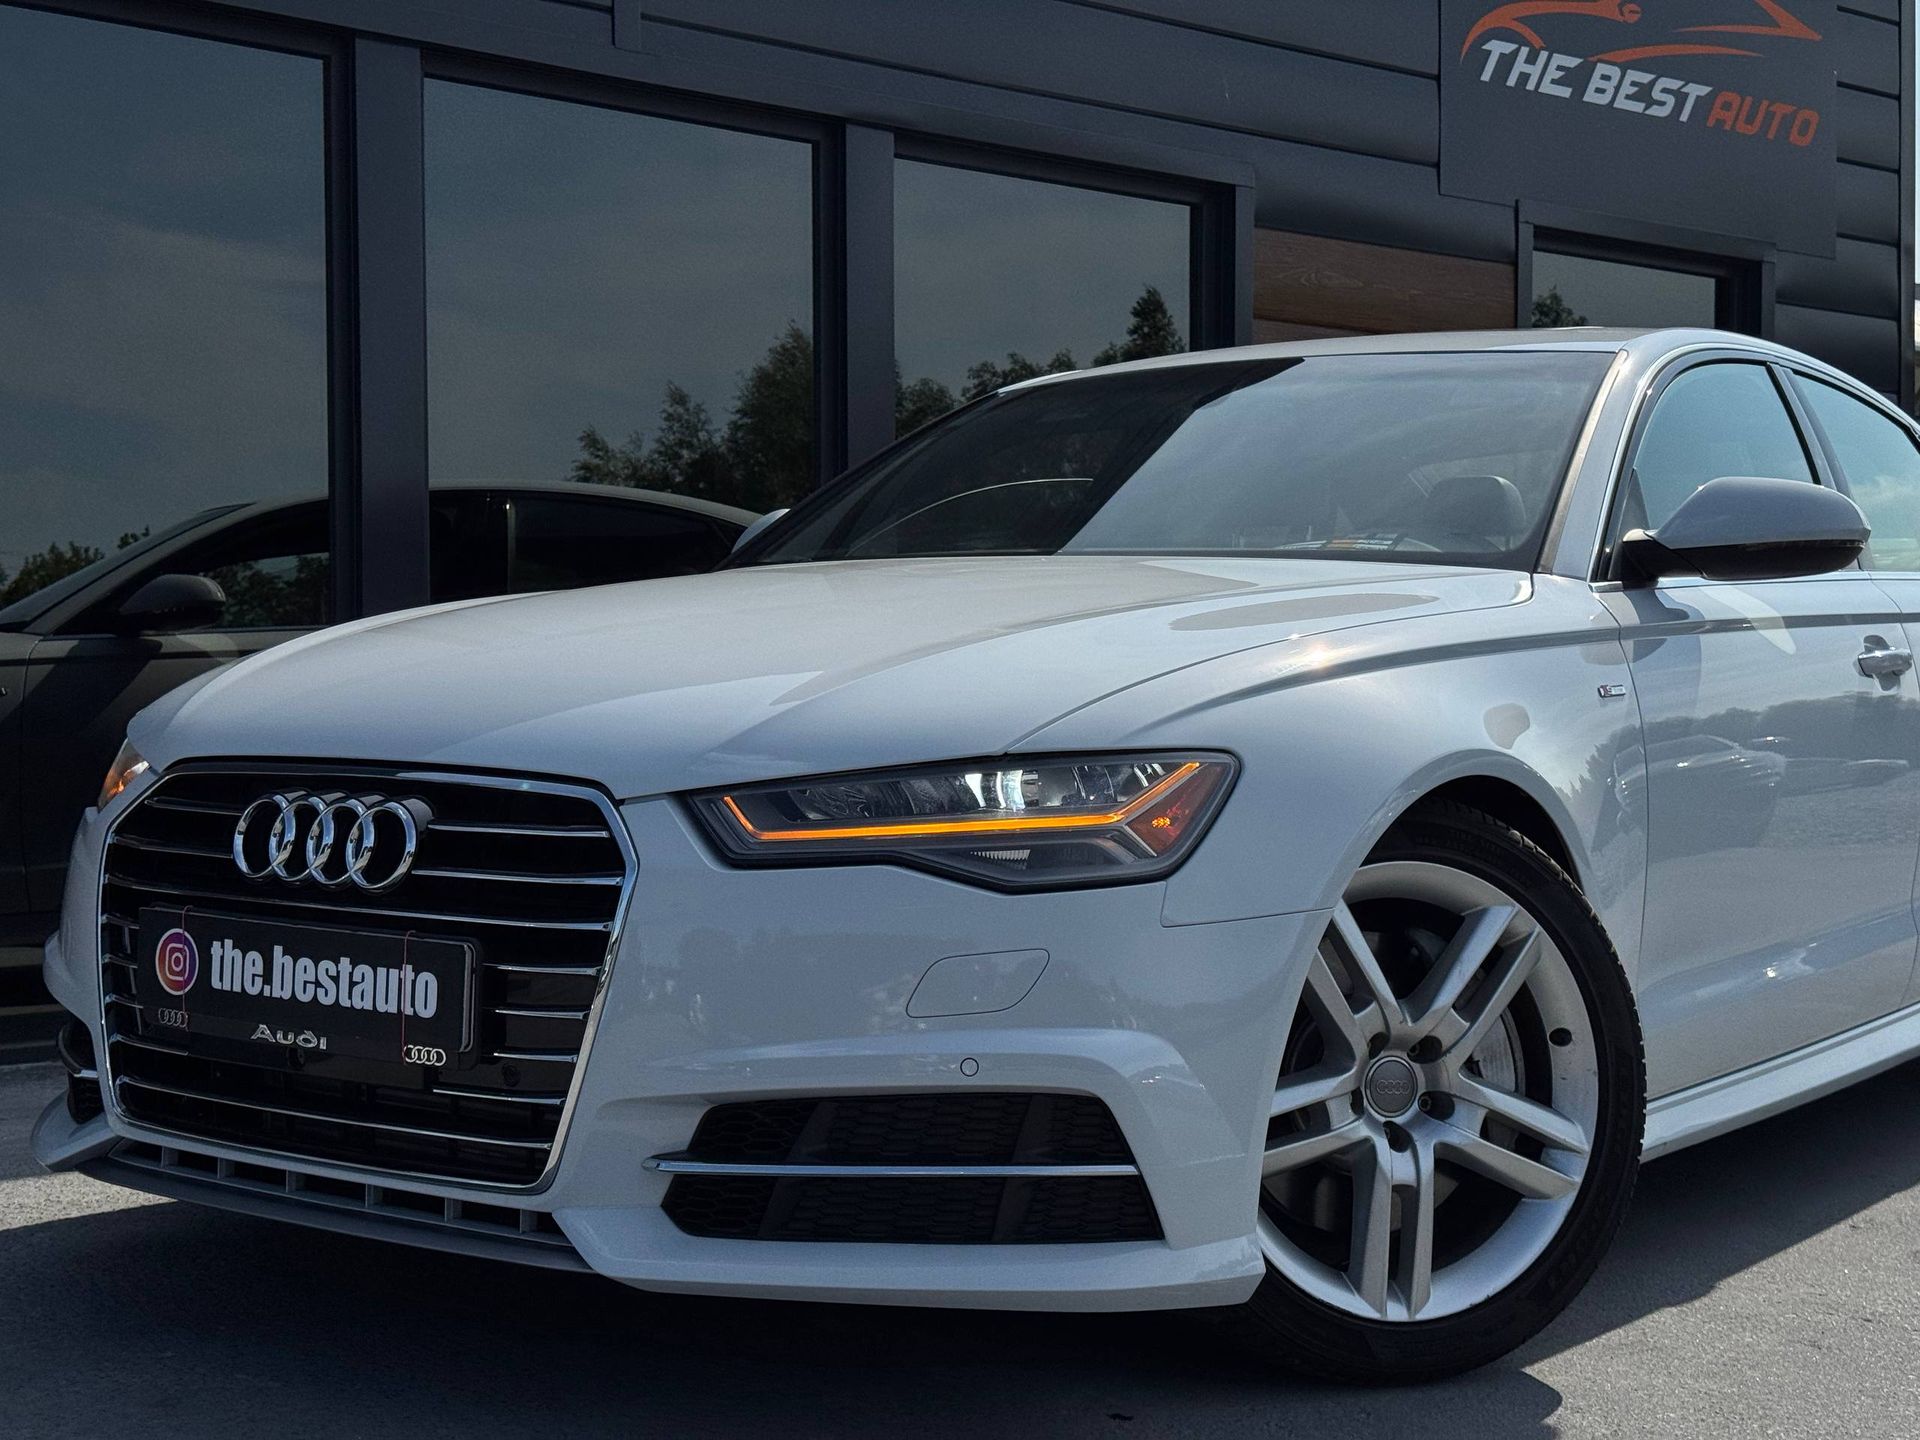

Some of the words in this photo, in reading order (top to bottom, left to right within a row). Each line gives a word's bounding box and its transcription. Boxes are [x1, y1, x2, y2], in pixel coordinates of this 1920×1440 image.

[1480, 39, 1584, 98] THE
[1583, 62, 1713, 122] BEST
[1707, 91, 1819, 146] AUTO
[210, 939, 438, 1019] the.bestauto
[250, 1024, 327, 1050] Audi
